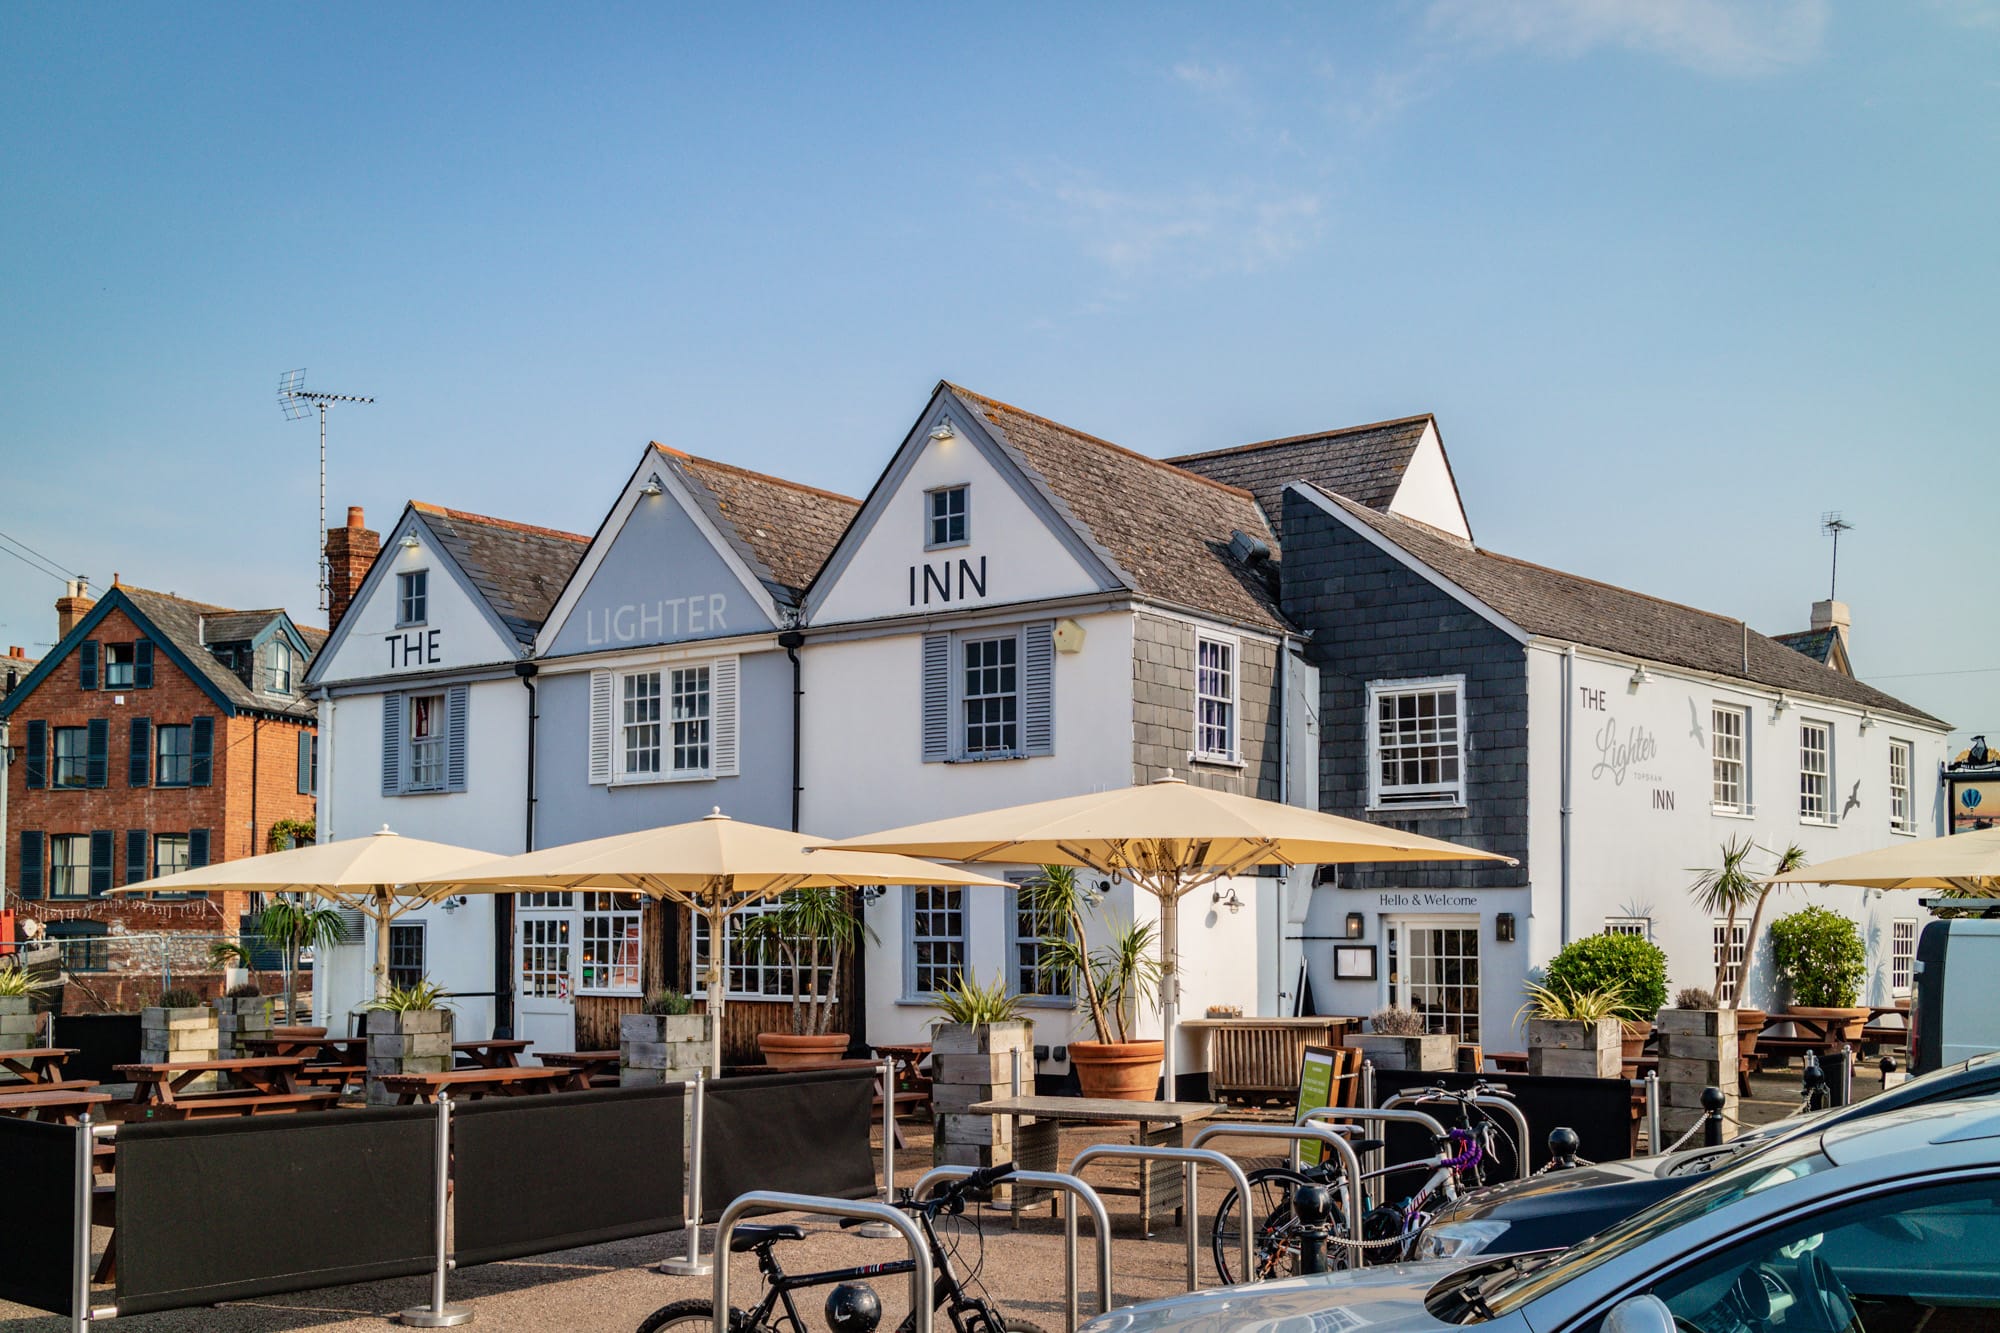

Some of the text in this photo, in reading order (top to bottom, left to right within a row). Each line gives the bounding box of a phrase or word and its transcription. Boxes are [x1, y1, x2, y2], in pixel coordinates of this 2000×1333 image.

[910, 555, 987, 606] INN
[587, 593, 728, 645] LIGHTER
[385, 629, 441, 668] THE
[1580, 686, 1606, 711] THE
[1591, 716, 1657, 786] Lighter
[1652, 788, 1674, 811] INN
[1379, 893, 1478, 906] Hello & Welcome
